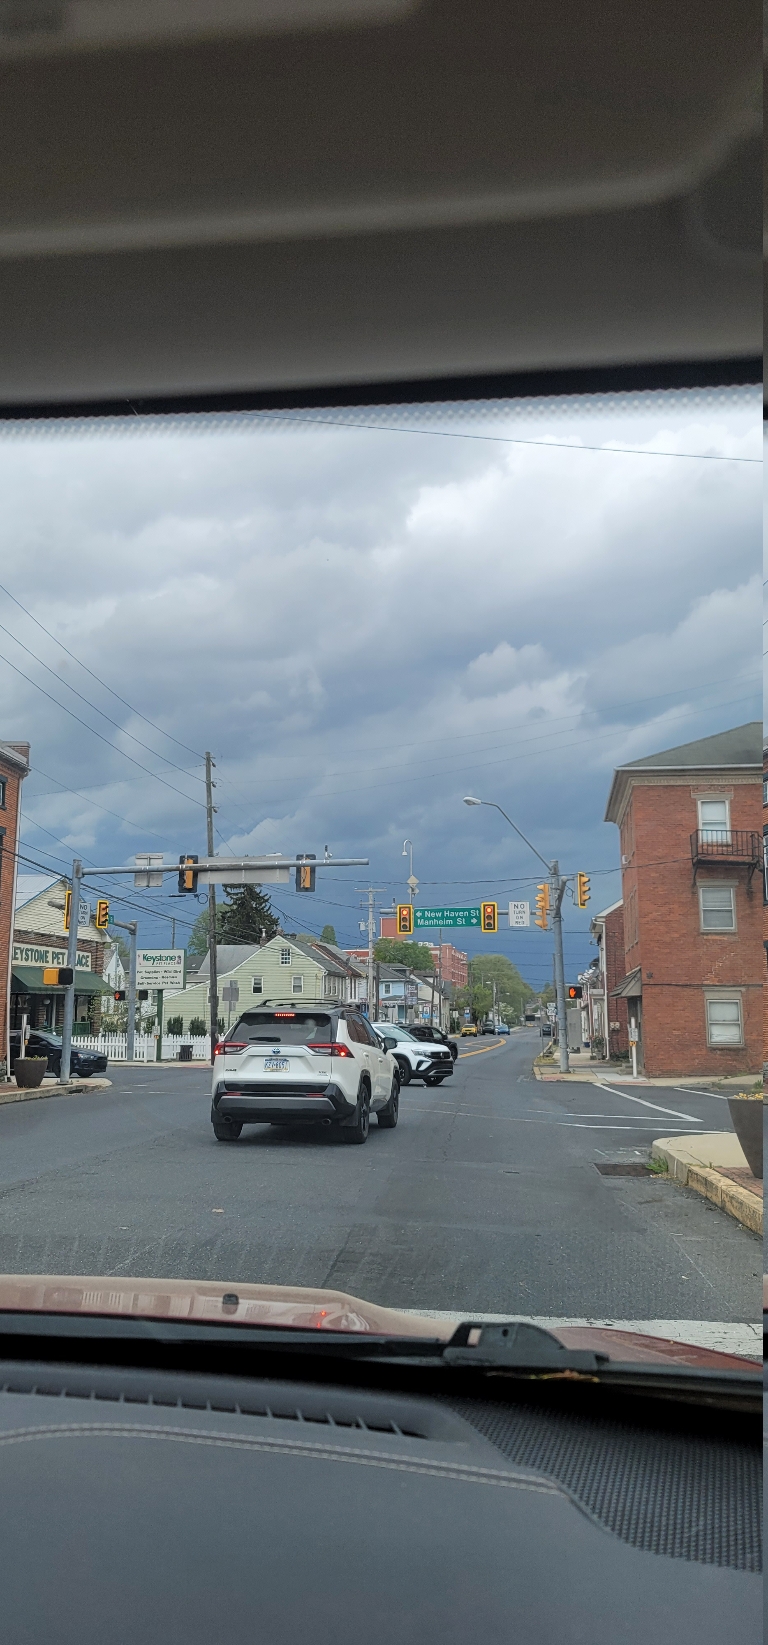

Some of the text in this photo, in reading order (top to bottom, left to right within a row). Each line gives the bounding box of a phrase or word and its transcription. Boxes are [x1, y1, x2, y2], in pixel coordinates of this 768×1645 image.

[417, 918, 454, 926] Manheim
[13, 946, 50, 964] EYSTONE
[52, 950, 66, 966] PET
[142, 954, 176, 966] Keystone
